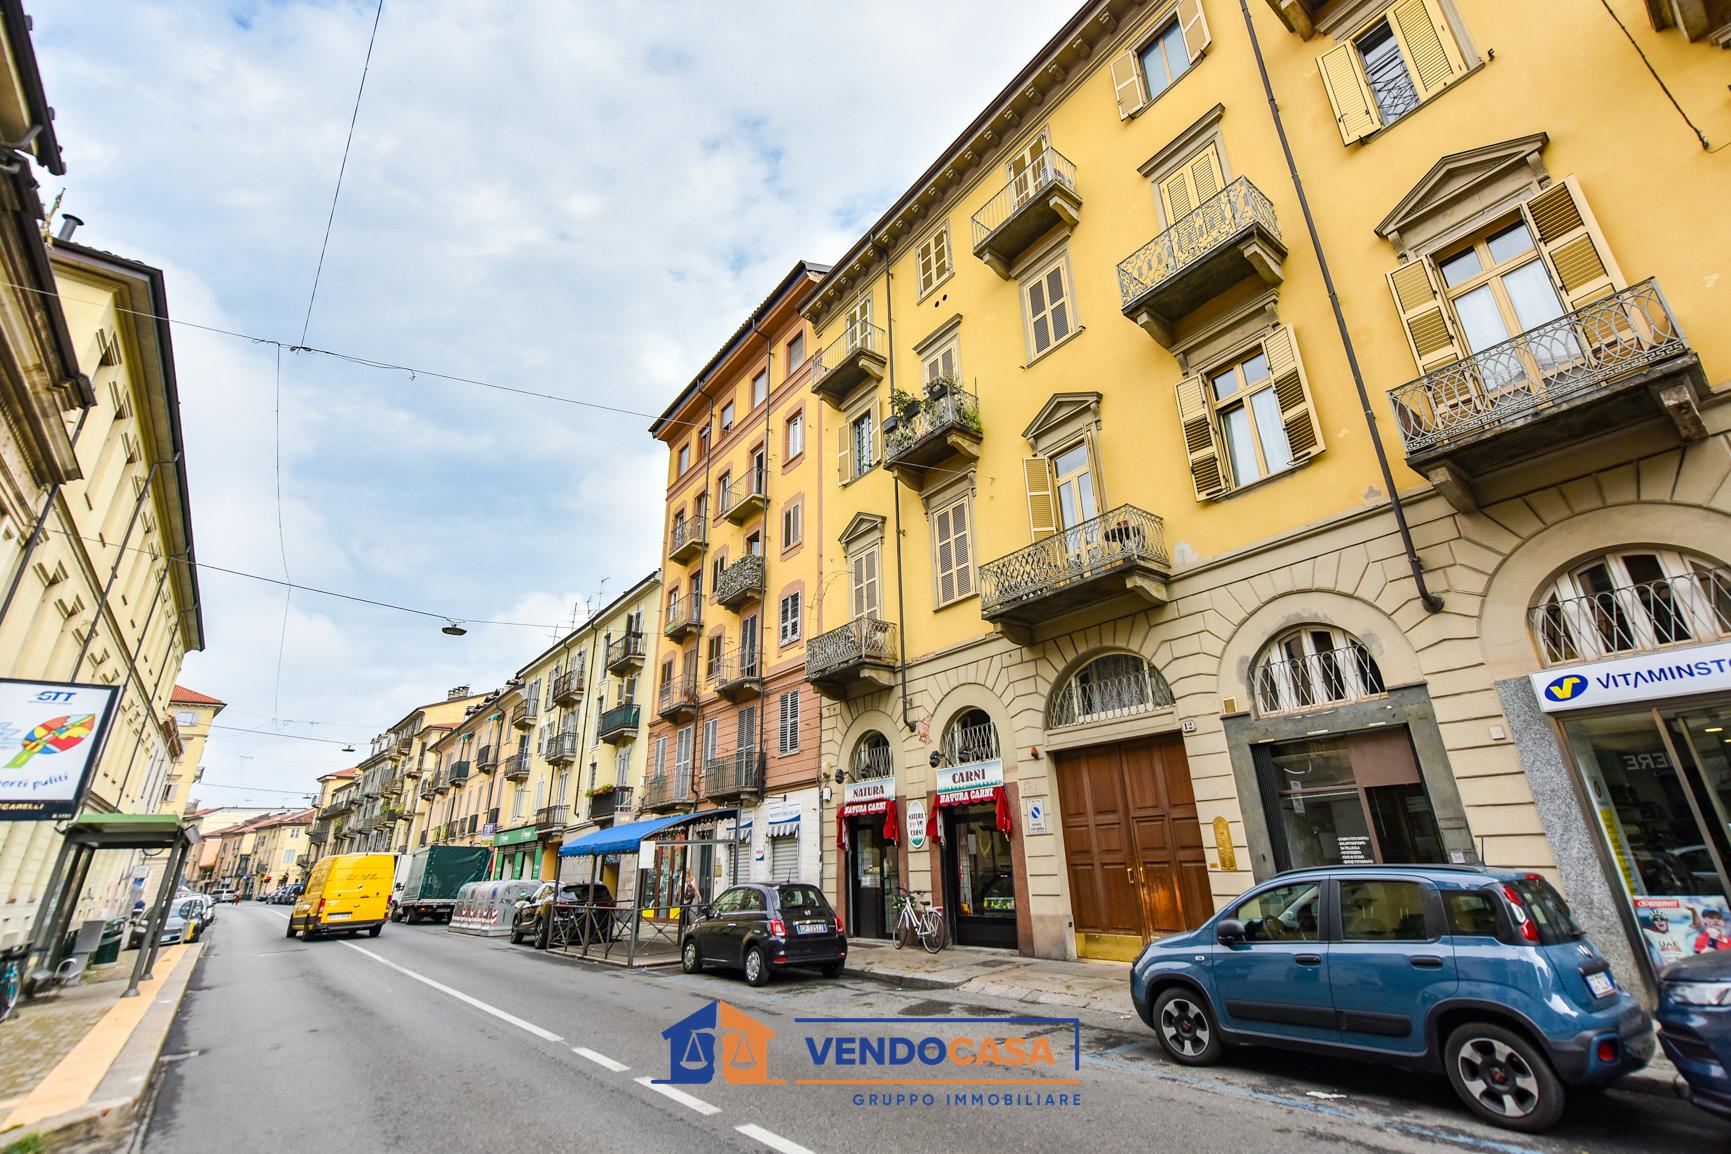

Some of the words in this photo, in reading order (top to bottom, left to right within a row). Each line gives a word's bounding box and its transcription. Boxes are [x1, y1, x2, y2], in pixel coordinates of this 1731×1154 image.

[1596, 659, 1731, 689] VITAMINST
[952, 768, 986, 784] CARNI
[853, 785, 884, 798] NATURA
[940, 792, 969, 804] NATURA
[970, 788, 994, 800] CARNI
[844, 804, 867, 814] NATURA
[868, 802, 886, 811] CARNI
